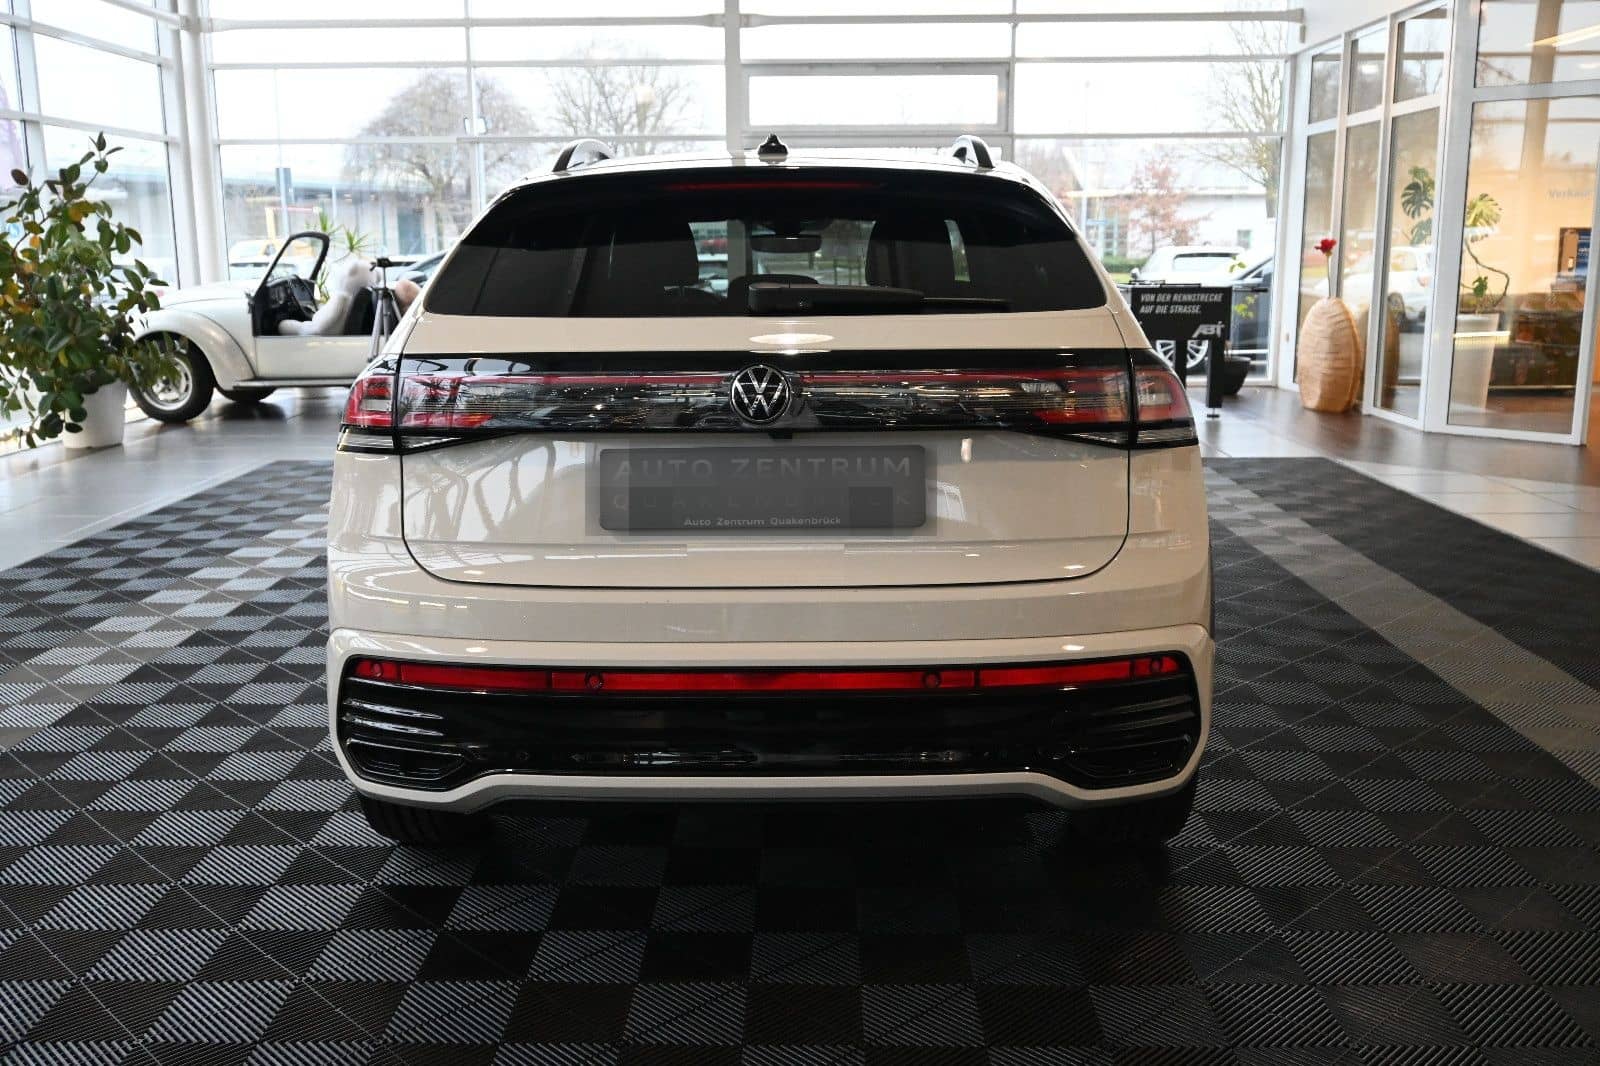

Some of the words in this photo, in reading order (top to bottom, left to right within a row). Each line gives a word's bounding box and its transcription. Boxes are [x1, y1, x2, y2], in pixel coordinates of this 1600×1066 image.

[1141, 293, 1156, 302] VON
[1156, 293, 1171, 302] DER
[1172, 293, 1223, 302] RENNSTRECKE
[1140, 305, 1154, 314] AUF
[1155, 305, 1169, 314] DIE
[1170, 305, 1202, 314] STRASSE.
[612, 460, 713, 480] AUTO
[731, 457, 911, 480] ZENTRUM
[684, 518, 712, 527] Auto
[716, 518, 765, 527] Zentrum
[771, 516, 841, 527] Quakenbrück
